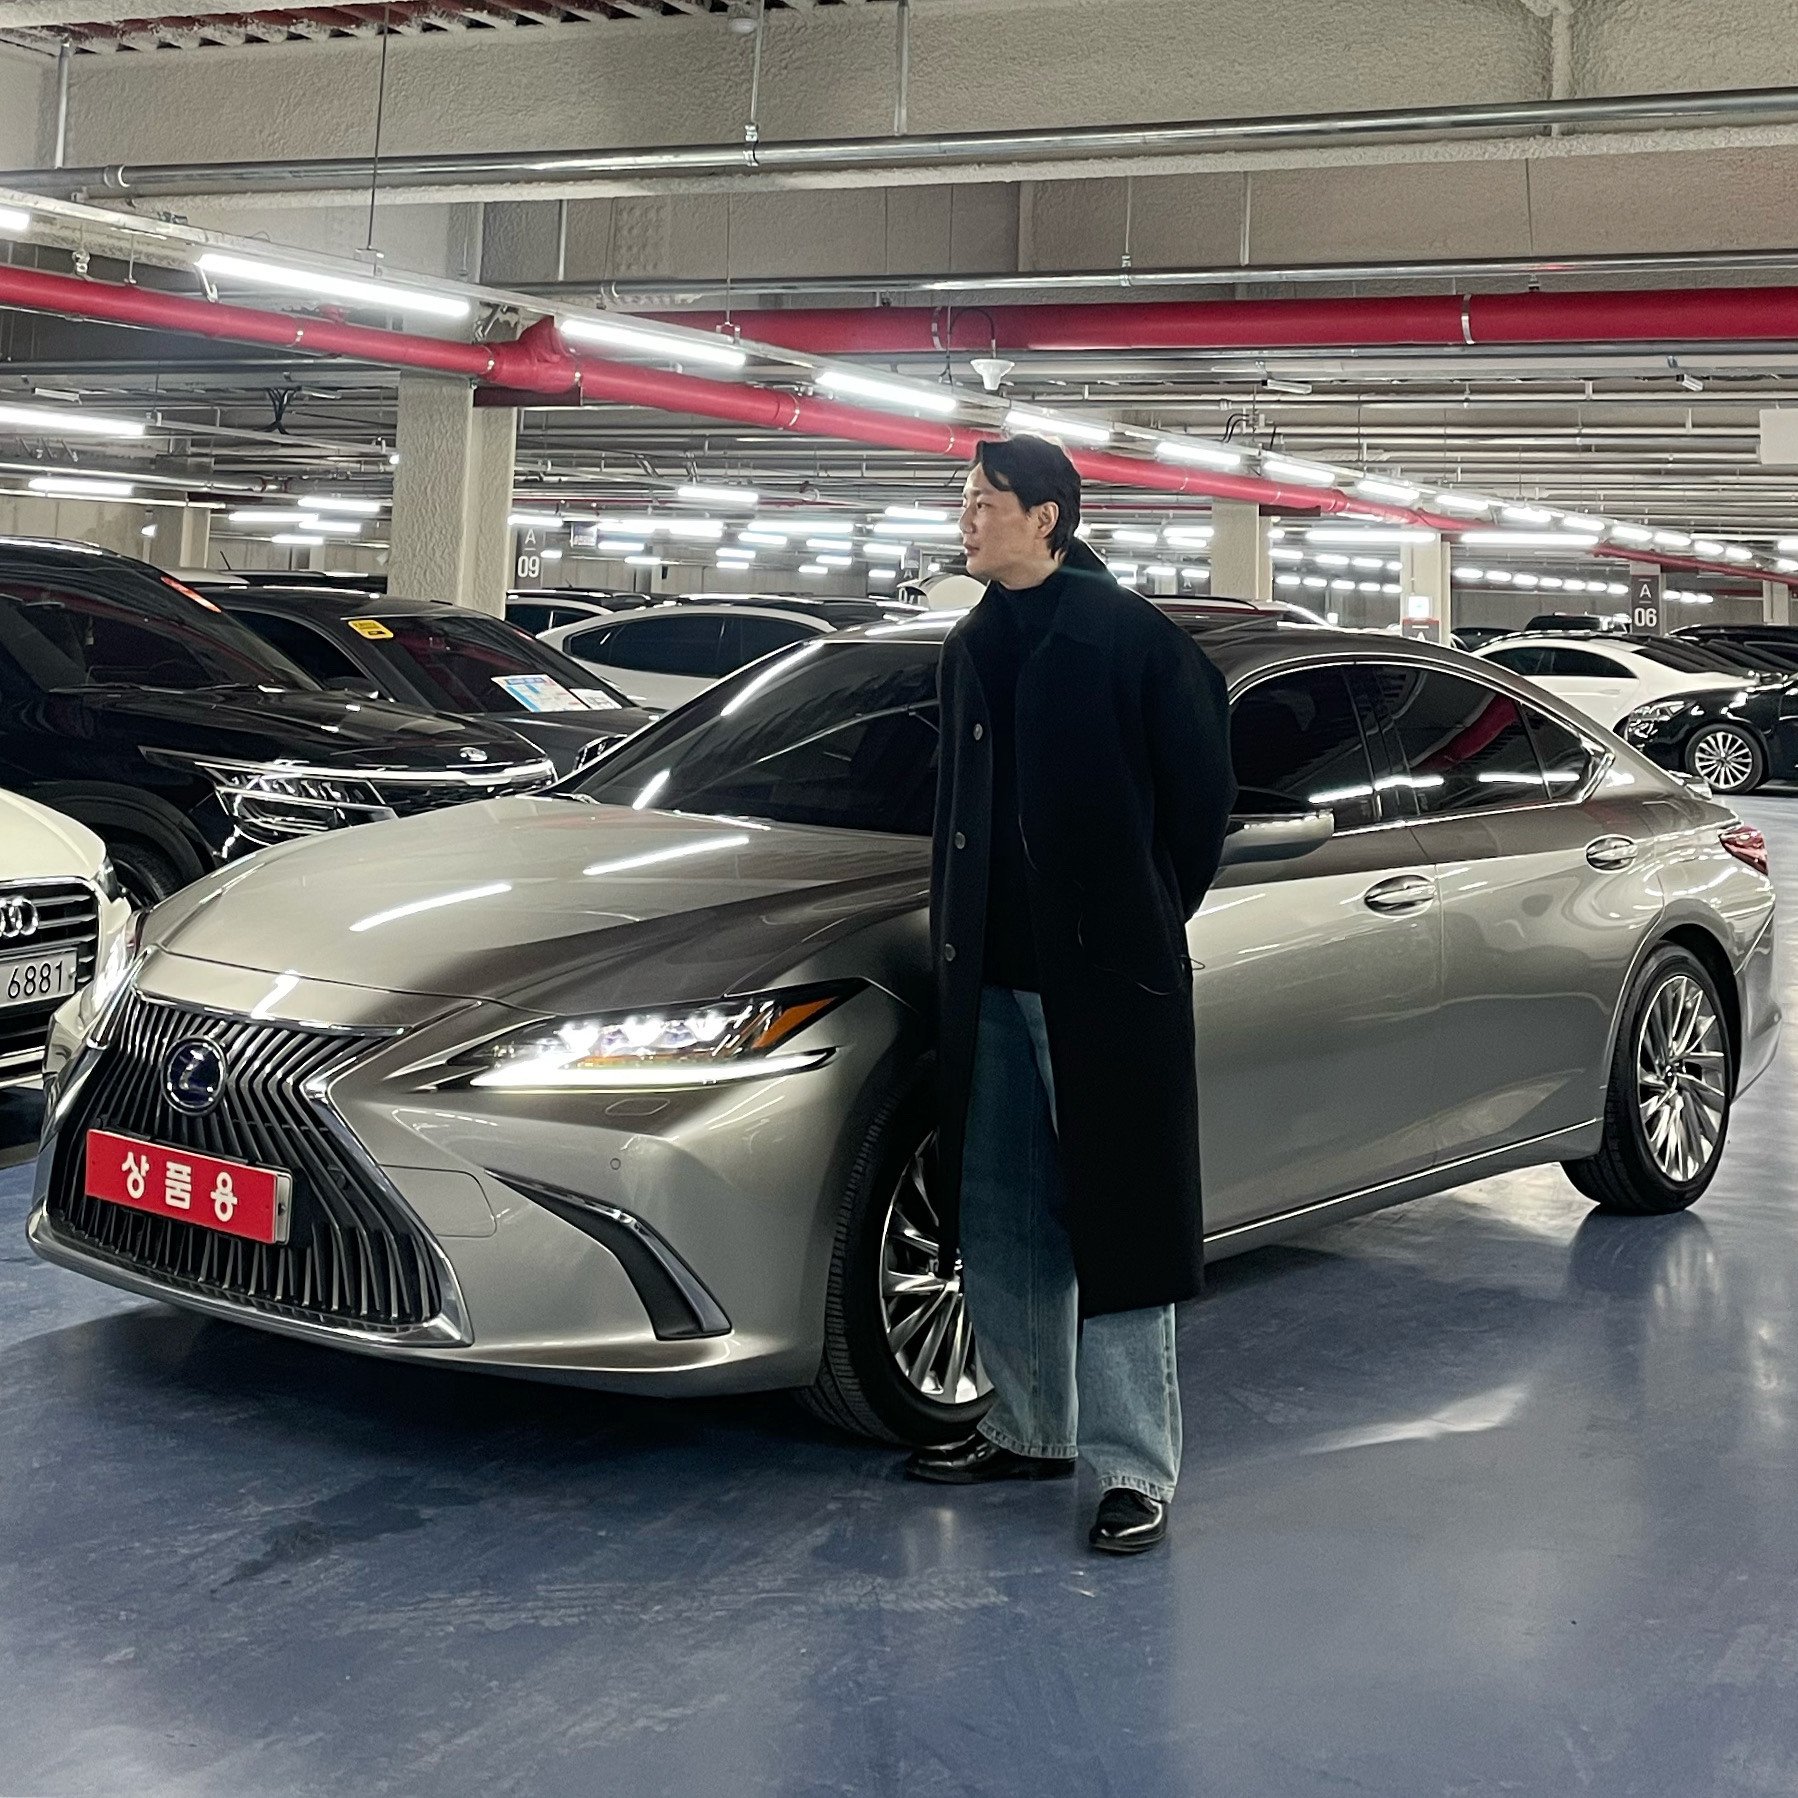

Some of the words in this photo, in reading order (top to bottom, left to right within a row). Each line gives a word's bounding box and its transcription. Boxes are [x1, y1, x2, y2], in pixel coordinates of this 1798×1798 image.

[524, 529, 536, 545] A
[517, 555, 540, 578] 09
[1639, 583, 1652, 599] A
[1634, 607, 1657, 628] 06
[8, 960, 63, 998] 6881
